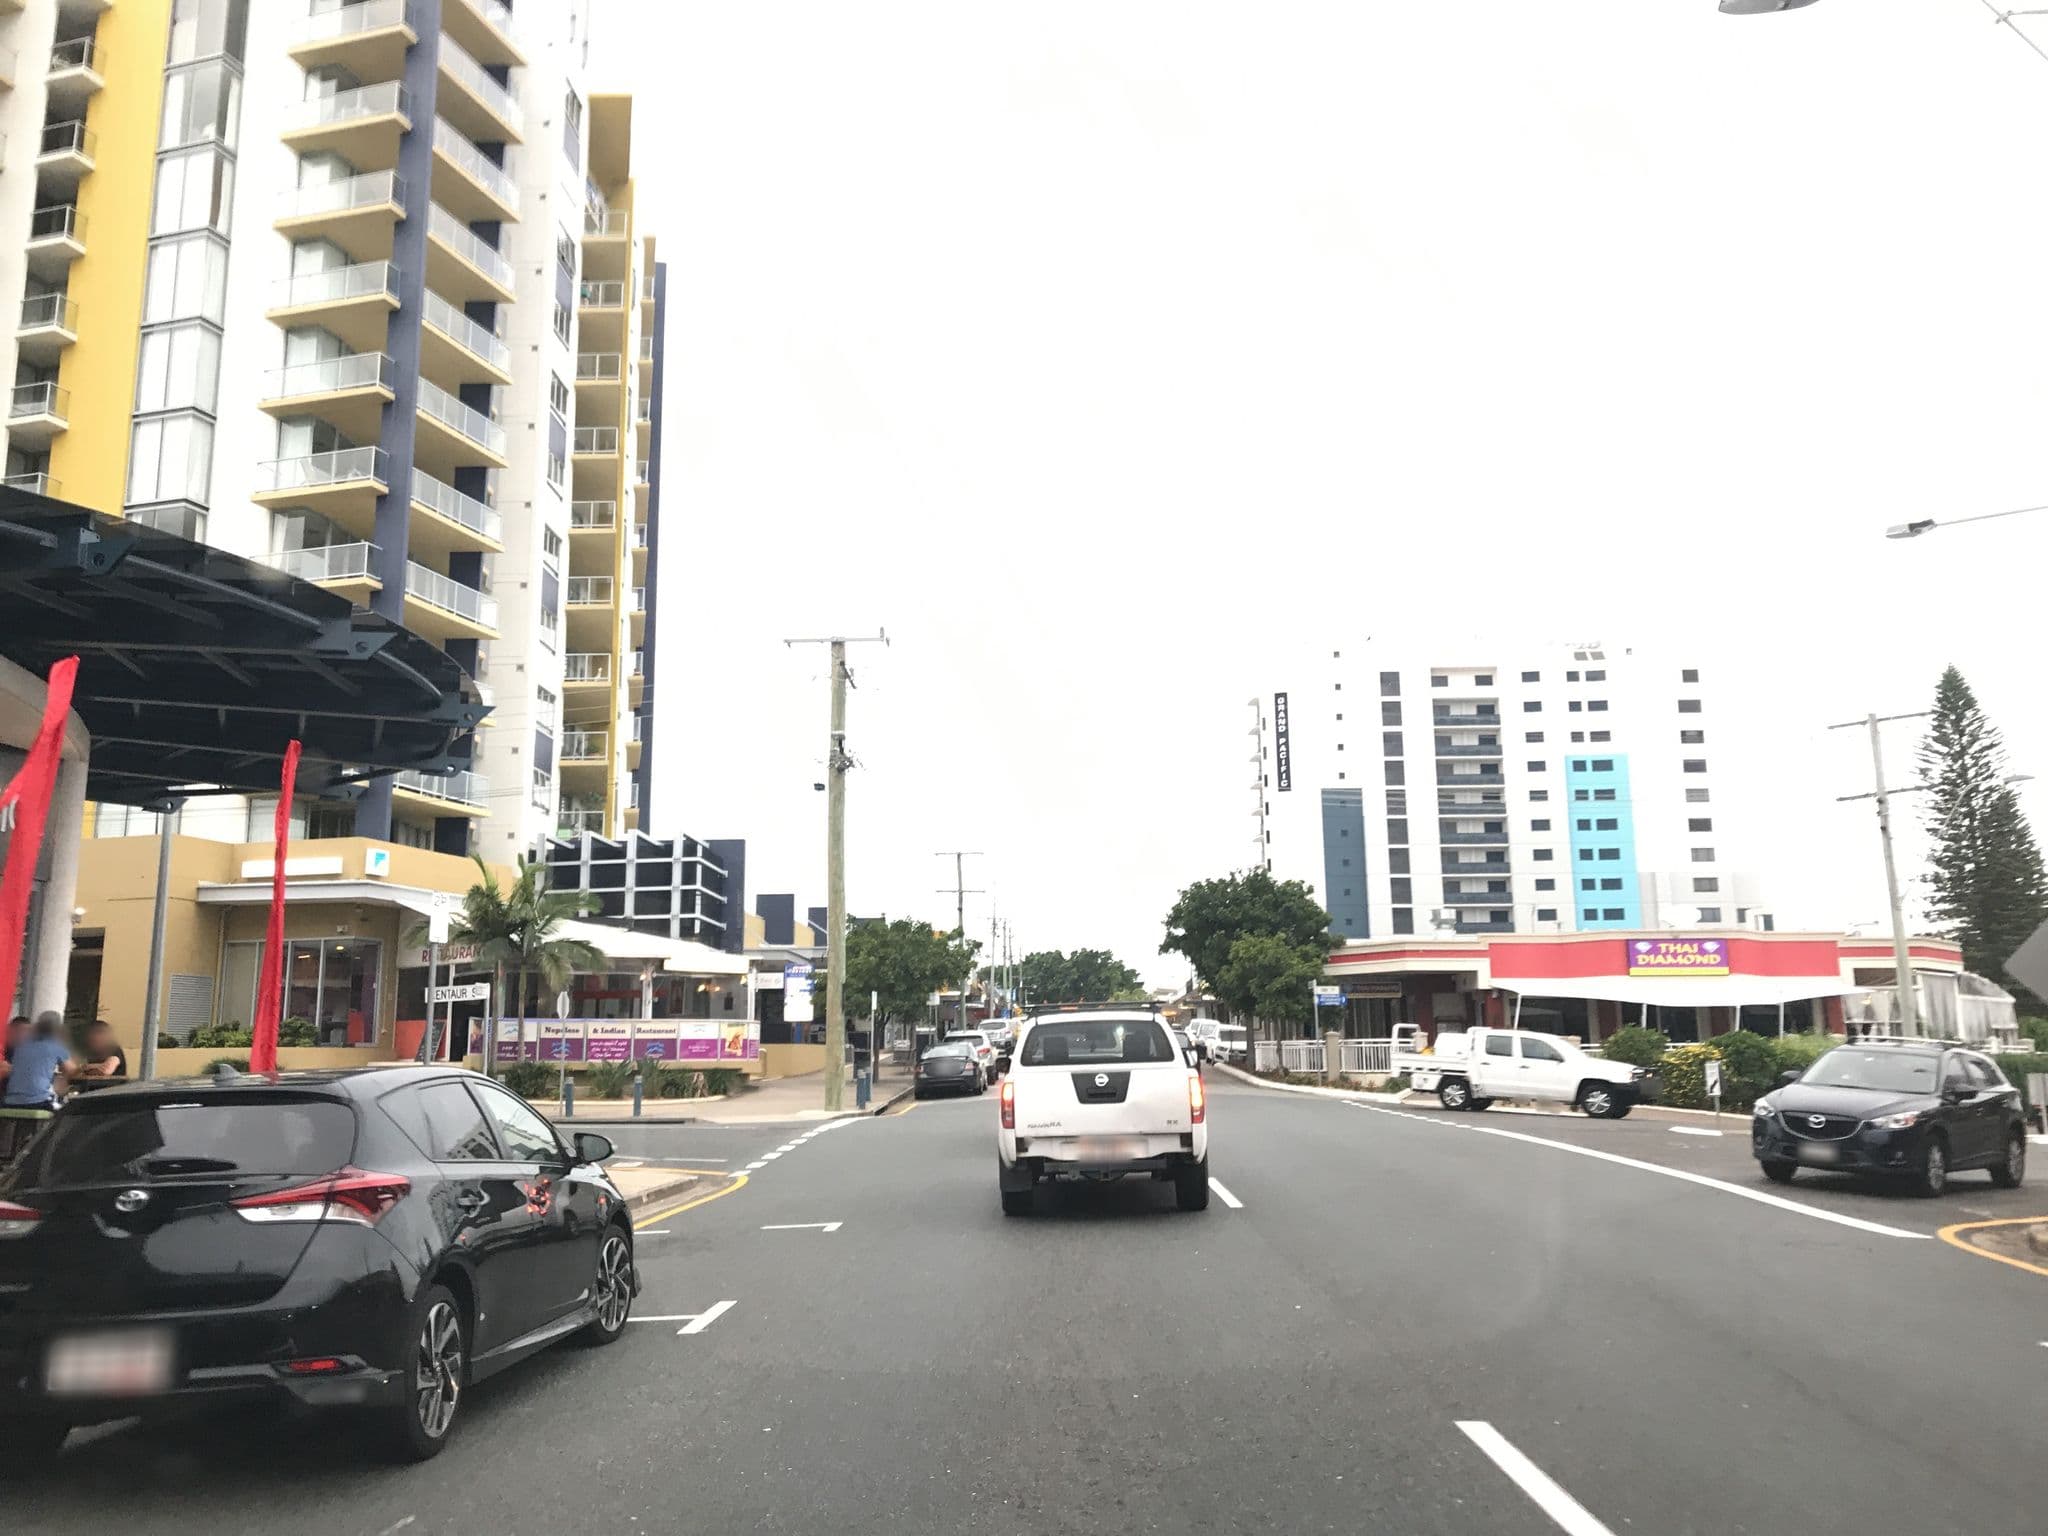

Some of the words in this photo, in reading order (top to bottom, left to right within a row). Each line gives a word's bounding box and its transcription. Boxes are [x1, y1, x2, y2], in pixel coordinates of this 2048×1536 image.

[1277, 696, 1287, 733] GRAND
[1279, 738, 1288, 787] PACIFIC
[1656, 942, 1699, 954] THAI
[1636, 953, 1722, 966] DIAMOND
[435, 987, 468, 1000] ENTAUR
